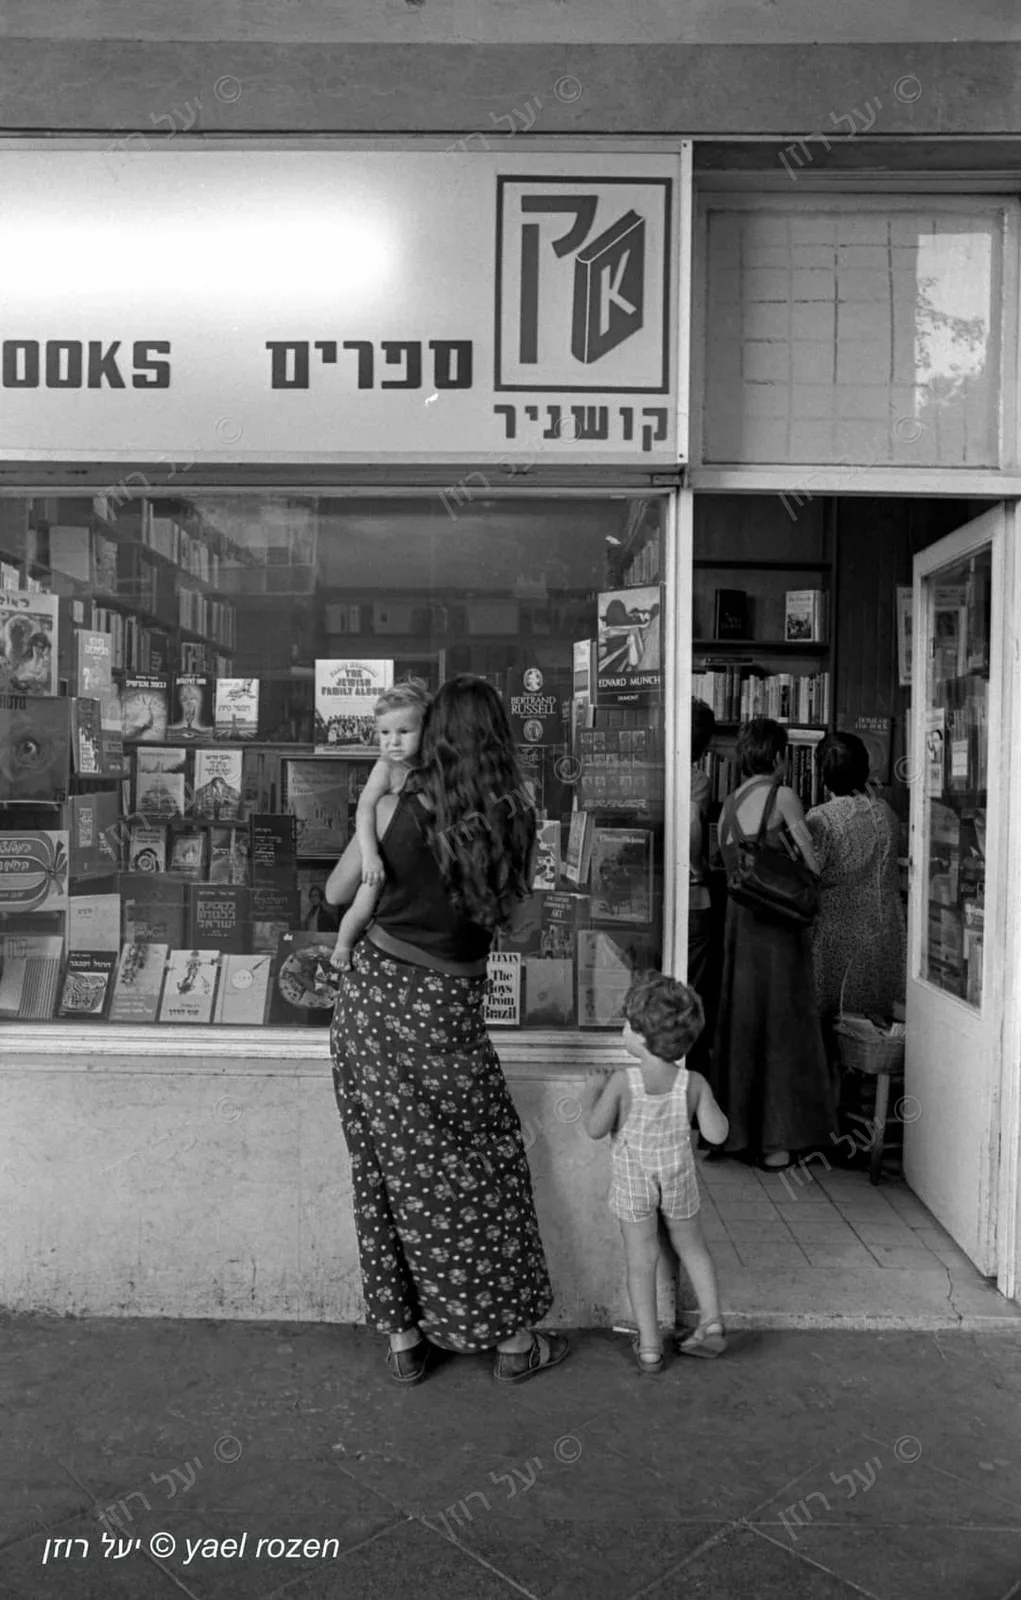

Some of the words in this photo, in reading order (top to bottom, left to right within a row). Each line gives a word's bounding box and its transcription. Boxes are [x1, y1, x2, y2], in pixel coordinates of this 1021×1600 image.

[2, 340, 171, 389] OOKS
[266, 340, 473, 389] ספרים
[494, 404, 668, 451] קושניר
[630, 675, 661, 686] MUNCH
[511, 696, 556, 705] BERTRAND
[511, 704, 556, 715] RUSSELL
[490, 970, 514, 981] The
[488, 994, 516, 1006] from
[484, 1005, 518, 1020] Brazil
